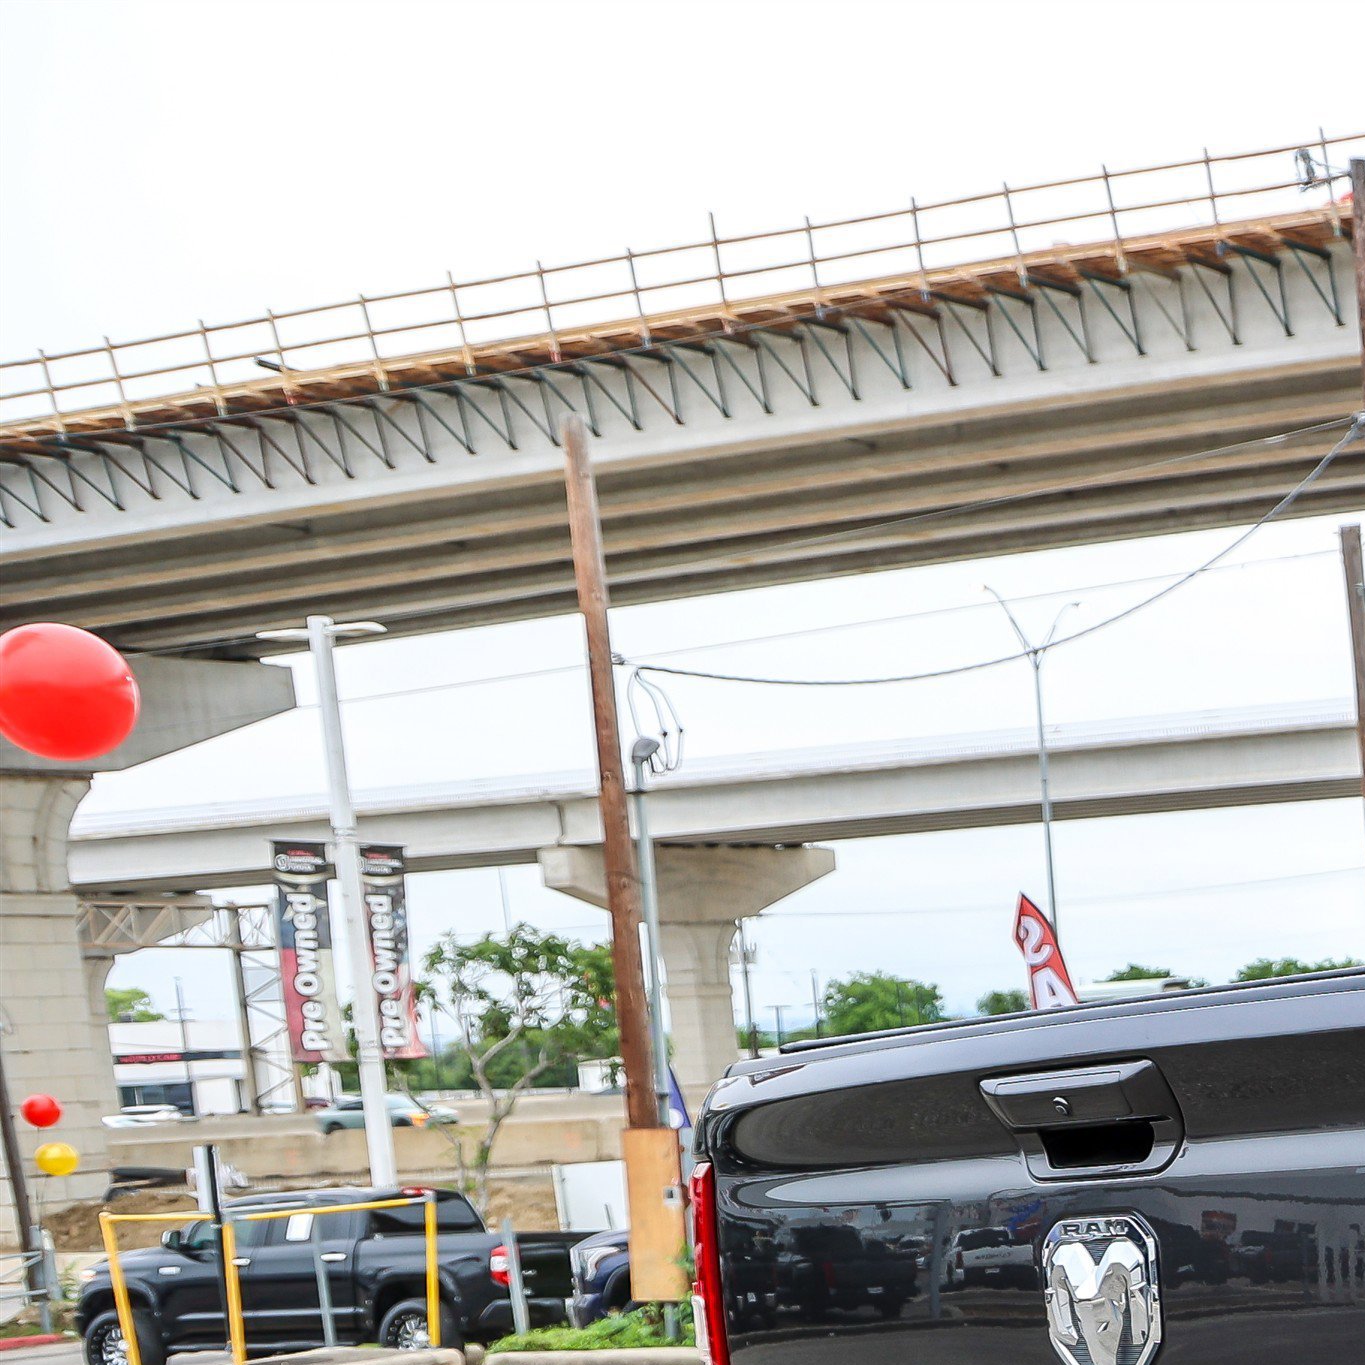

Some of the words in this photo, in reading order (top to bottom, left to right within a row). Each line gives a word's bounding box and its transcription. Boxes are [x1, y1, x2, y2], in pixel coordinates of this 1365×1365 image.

[286, 892, 324, 996] Owned
[365, 893, 399, 995] Owned
[301, 1000, 333, 1050] Pre
[380, 1000, 408, 1048] Pre
[1061, 1219, 1128, 1237] RAM
